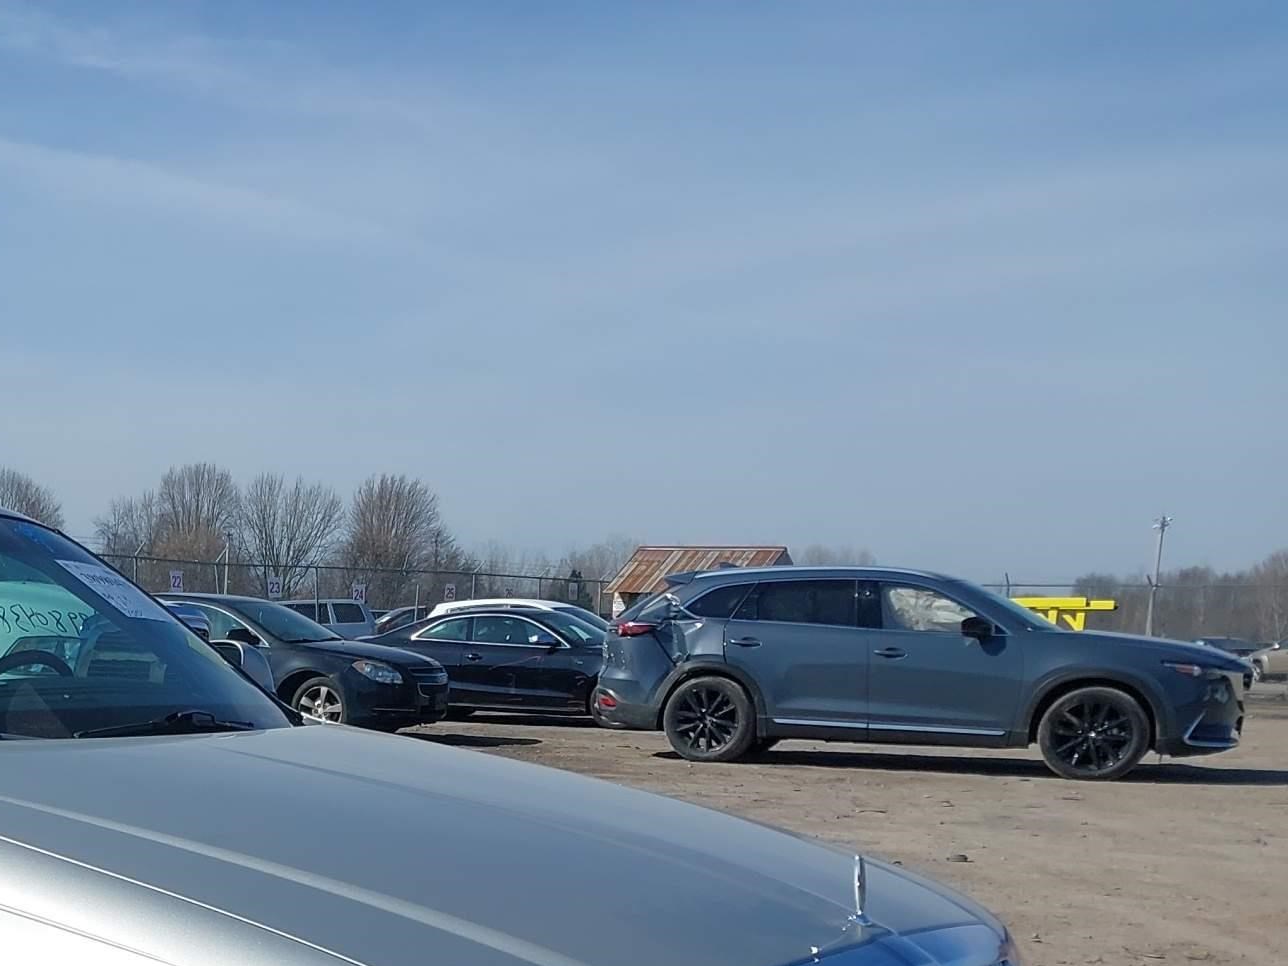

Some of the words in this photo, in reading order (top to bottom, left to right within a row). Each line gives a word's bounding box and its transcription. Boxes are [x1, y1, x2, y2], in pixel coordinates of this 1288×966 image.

[171, 575, 182, 588] 22
[269, 582, 281, 594] 23
[353, 588, 364, 601] 24
